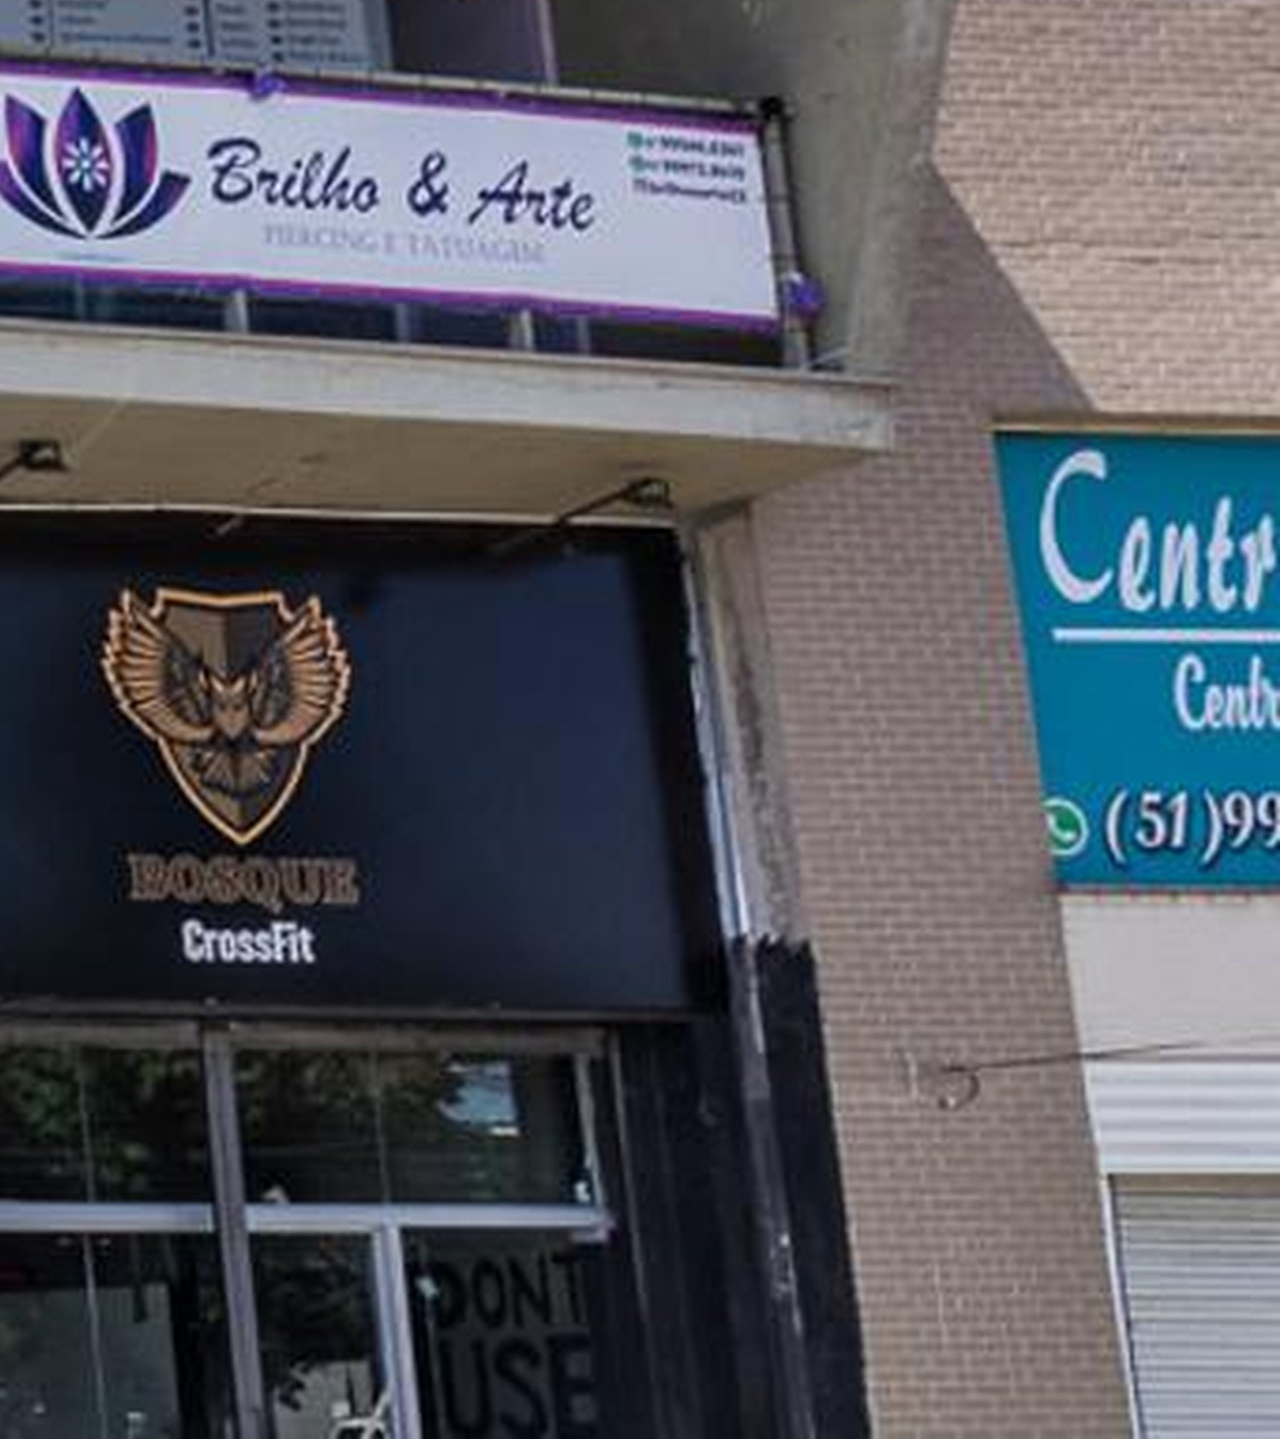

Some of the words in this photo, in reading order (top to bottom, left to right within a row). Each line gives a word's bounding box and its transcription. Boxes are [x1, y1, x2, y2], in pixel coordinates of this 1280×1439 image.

[207, 136, 381, 215] Brilho
[406, 150, 450, 217] &
[468, 160, 596, 232] Arte
[128, 852, 360, 913] BOSQUE
[181, 918, 316, 964] CrossFit
